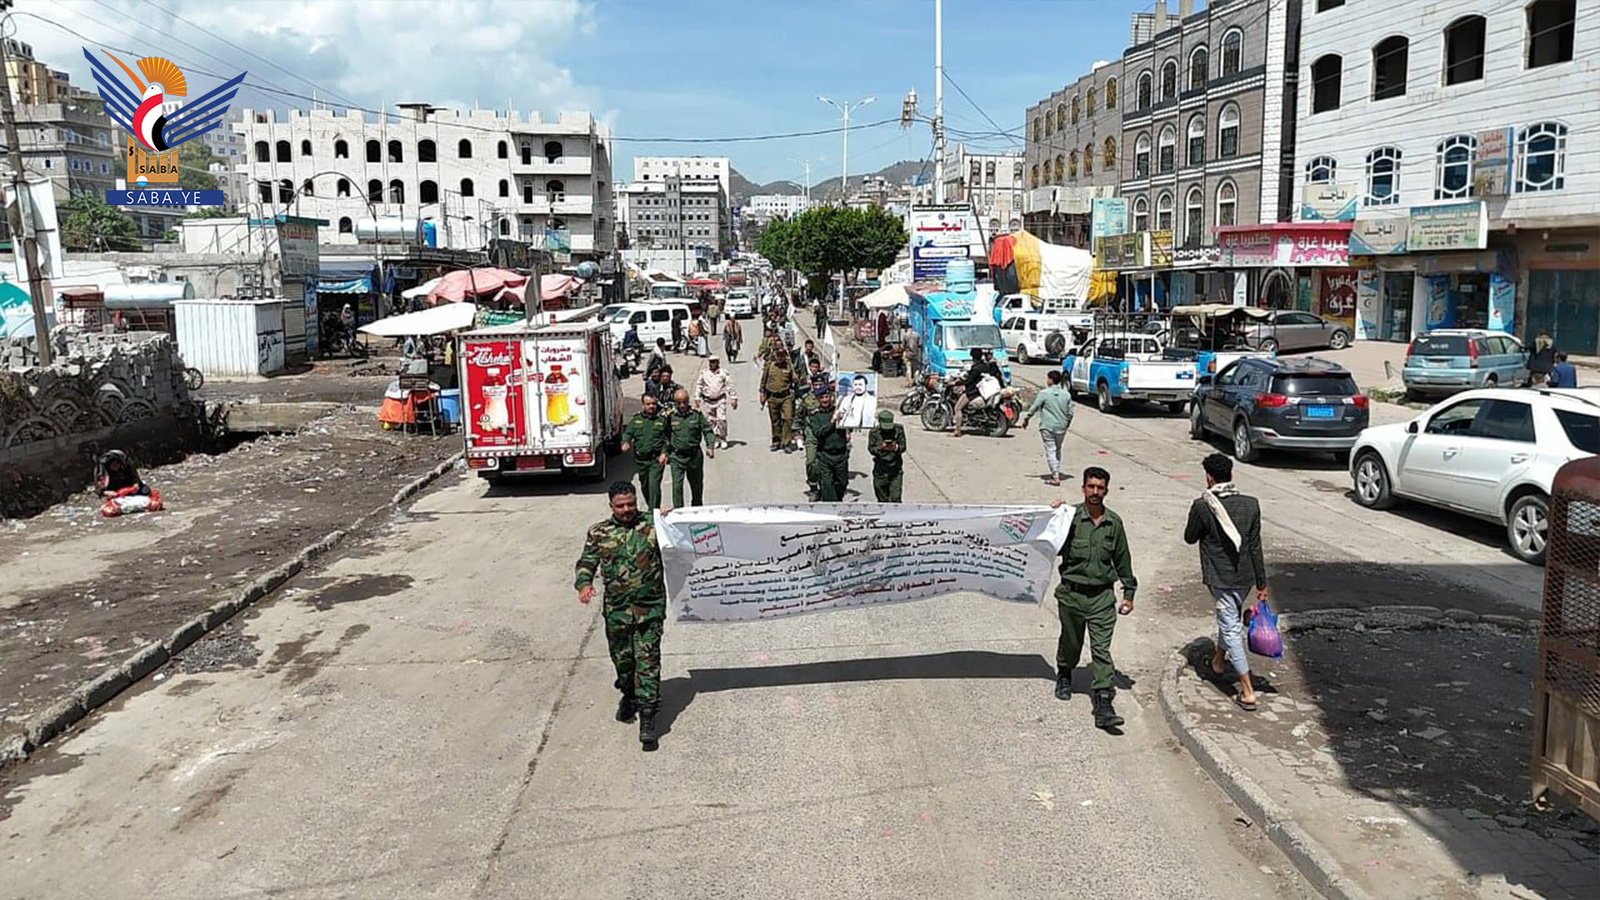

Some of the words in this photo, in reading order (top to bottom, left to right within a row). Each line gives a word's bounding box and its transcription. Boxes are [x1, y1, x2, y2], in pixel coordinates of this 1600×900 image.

[1298, 236, 1318, 251] غزة
[541, 344, 571, 354] مشروبات
[780, 525, 842, 547] المجتمع
[735, 556, 774, 569] الدين
[688, 563, 733, 577] الحوثي
[742, 568, 783, 577] محمد
